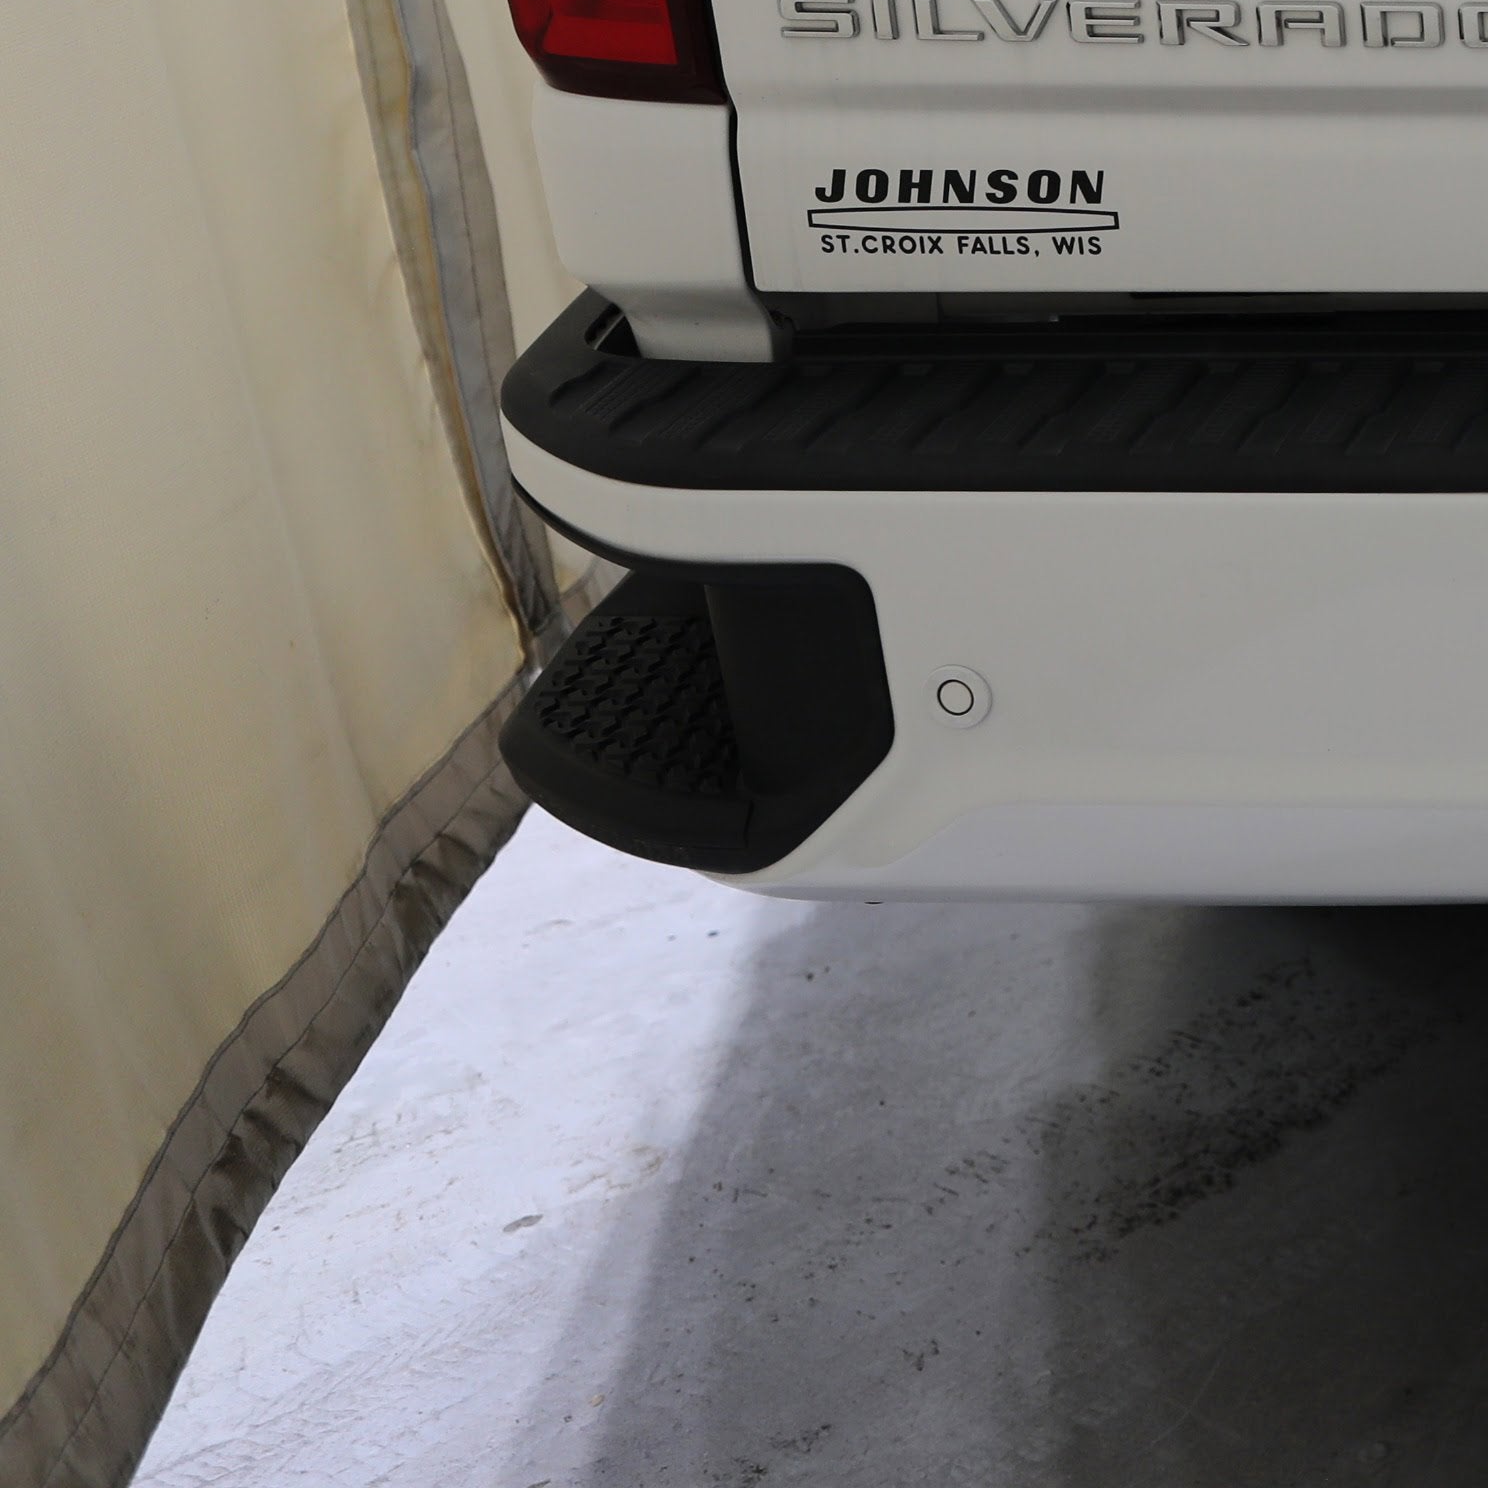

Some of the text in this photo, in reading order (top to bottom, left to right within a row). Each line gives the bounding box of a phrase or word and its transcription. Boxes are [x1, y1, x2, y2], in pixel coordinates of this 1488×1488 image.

[814, 168, 1106, 205] JOHNSON
[956, 235, 1041, 258] FALLS,
[1051, 236, 1103, 256] WIS
